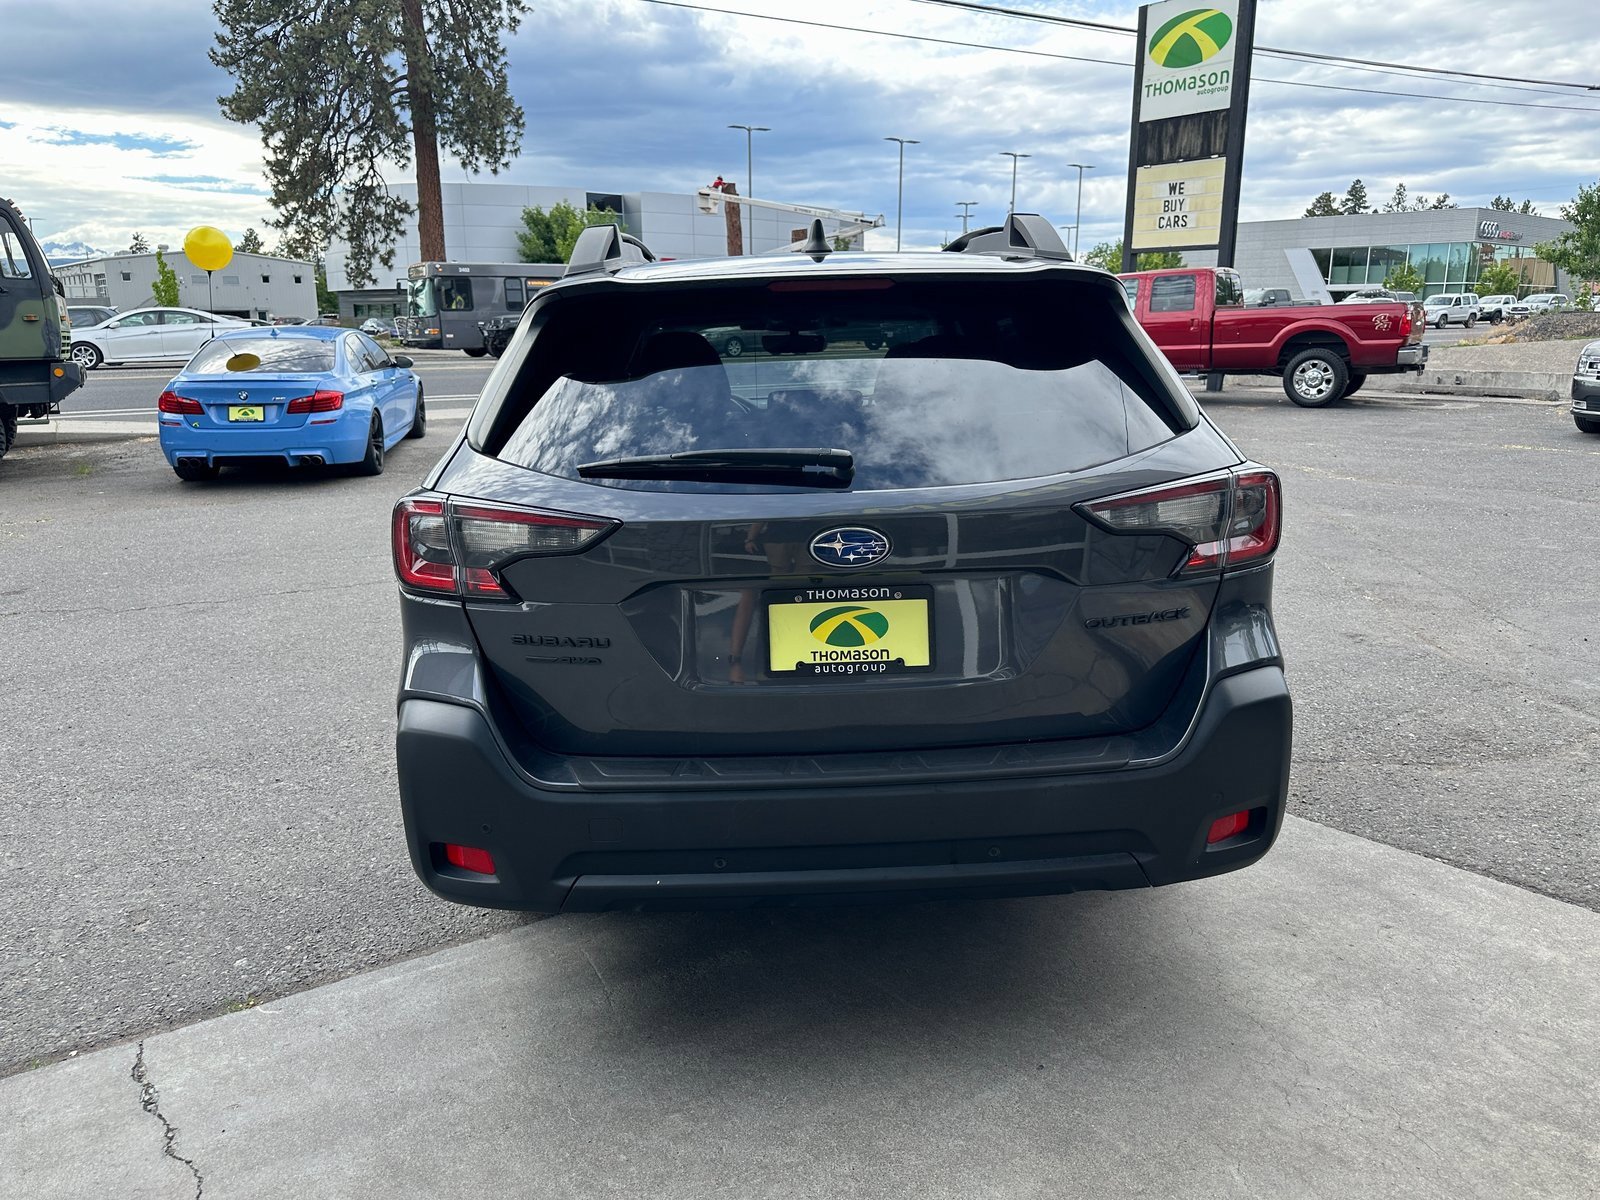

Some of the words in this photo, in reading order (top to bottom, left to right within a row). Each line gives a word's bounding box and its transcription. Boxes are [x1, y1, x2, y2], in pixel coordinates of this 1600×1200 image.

[1196, 85, 1229, 96] autogroup
[1168, 181, 1185, 195] WE
[1163, 199, 1185, 213] BUY
[1158, 214, 1188, 229] CARS
[1084, 606, 1192, 630] OUTBACK
[511, 633, 611, 649] SUBARU
[814, 663, 887, 674] autogroup
